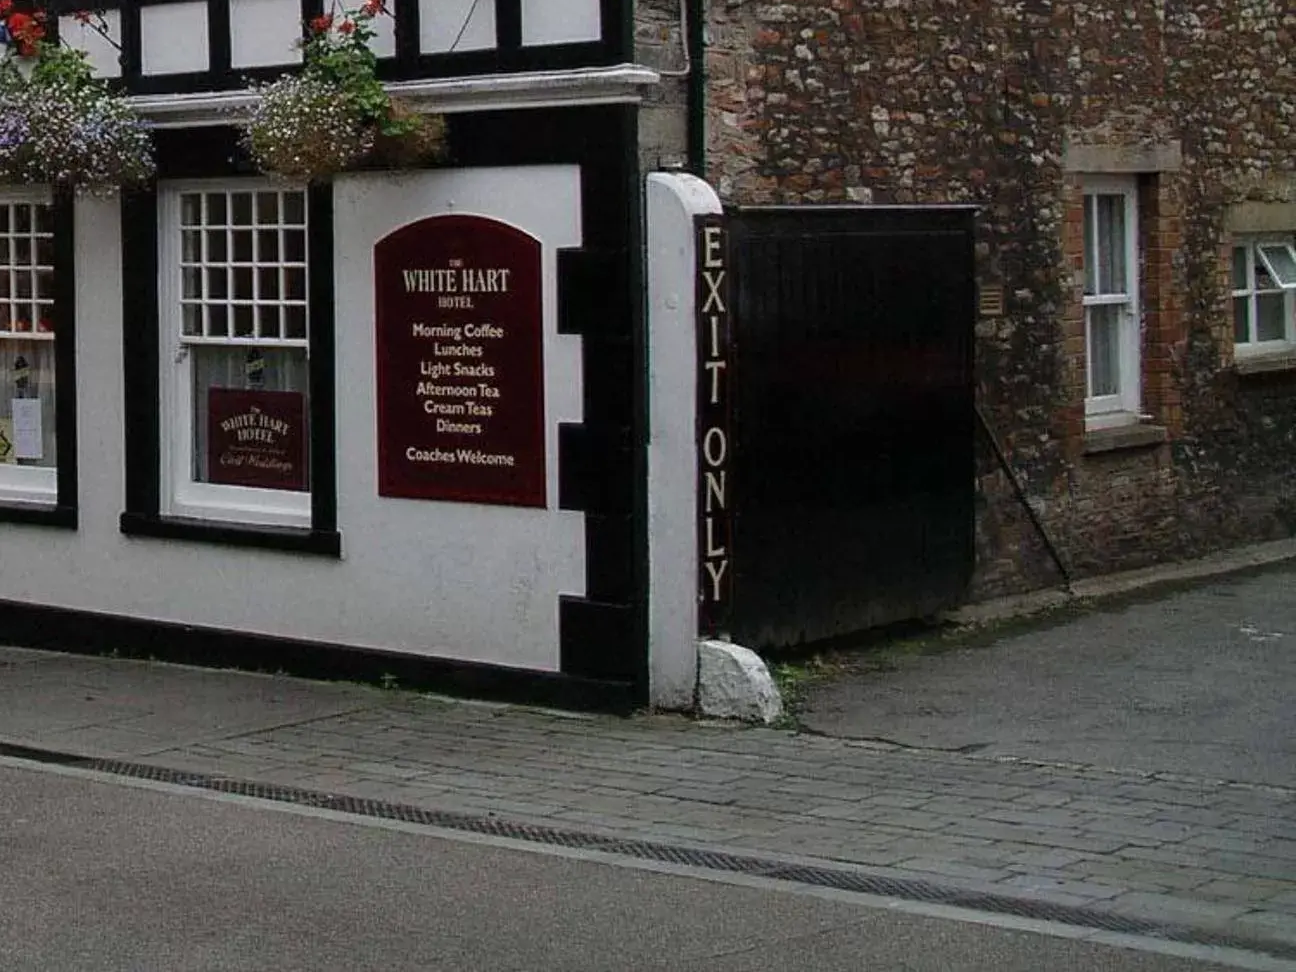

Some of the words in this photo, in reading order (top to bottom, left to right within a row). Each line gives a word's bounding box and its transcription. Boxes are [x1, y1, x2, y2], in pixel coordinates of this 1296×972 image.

[403, 269, 456, 292] WHITE
[462, 269, 510, 292] HART
[438, 296, 473, 308] HOTEL
[703, 228, 726, 403] EXIT
[413, 323, 461, 340] Morning
[464, 323, 504, 338] Coffee
[434, 343, 483, 357] Lunches
[421, 361, 451, 378] Light
[454, 362, 495, 377] Snacks
[416, 382, 477, 396] Afternoon
[478, 384, 500, 398] Tea
[424, 400, 465, 414] Cream
[465, 401, 492, 416] Teas
[437, 419, 481, 434] Dinners
[406, 447, 455, 462] Coaches
[456, 449, 515, 466] Welcome
[703, 427, 728, 601] ONLY
